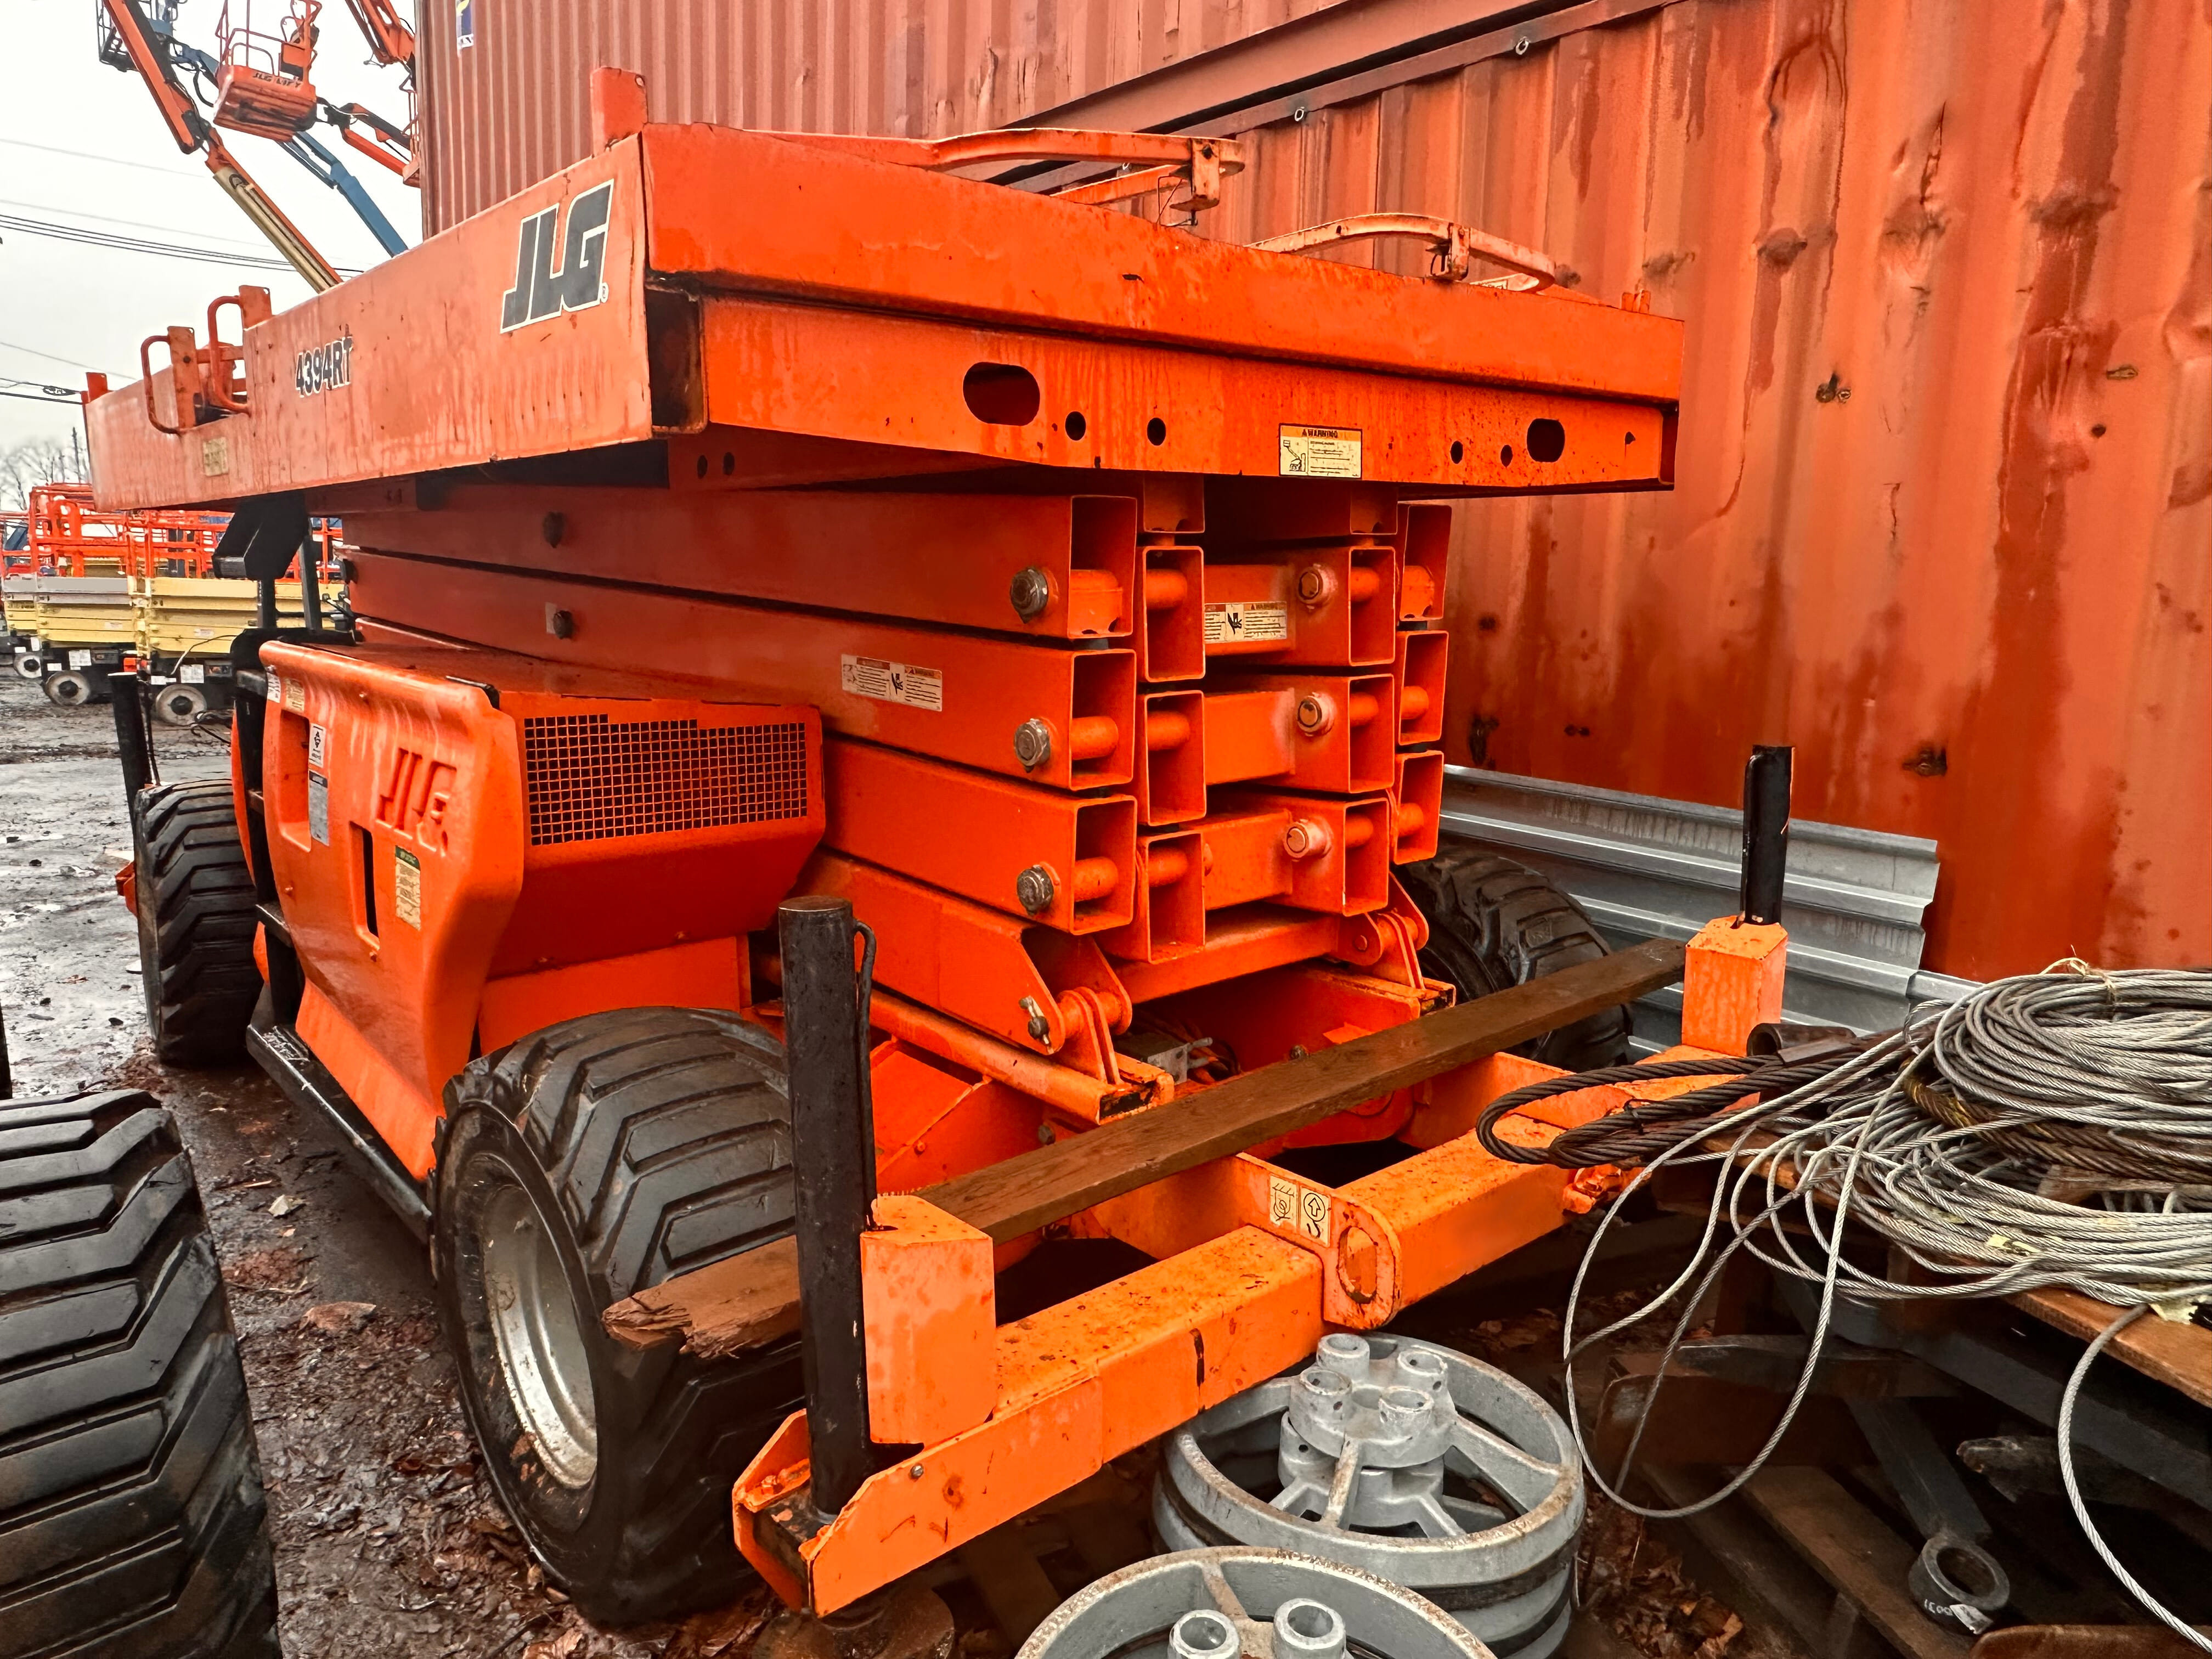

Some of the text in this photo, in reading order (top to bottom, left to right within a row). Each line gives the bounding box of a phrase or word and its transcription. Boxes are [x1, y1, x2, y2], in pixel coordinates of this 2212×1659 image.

[500, 179, 614, 334] JLG
[295, 336, 354, 398] 4394RT
[1307, 428, 1339, 438] WARNING
[376, 747, 457, 853] JLG
